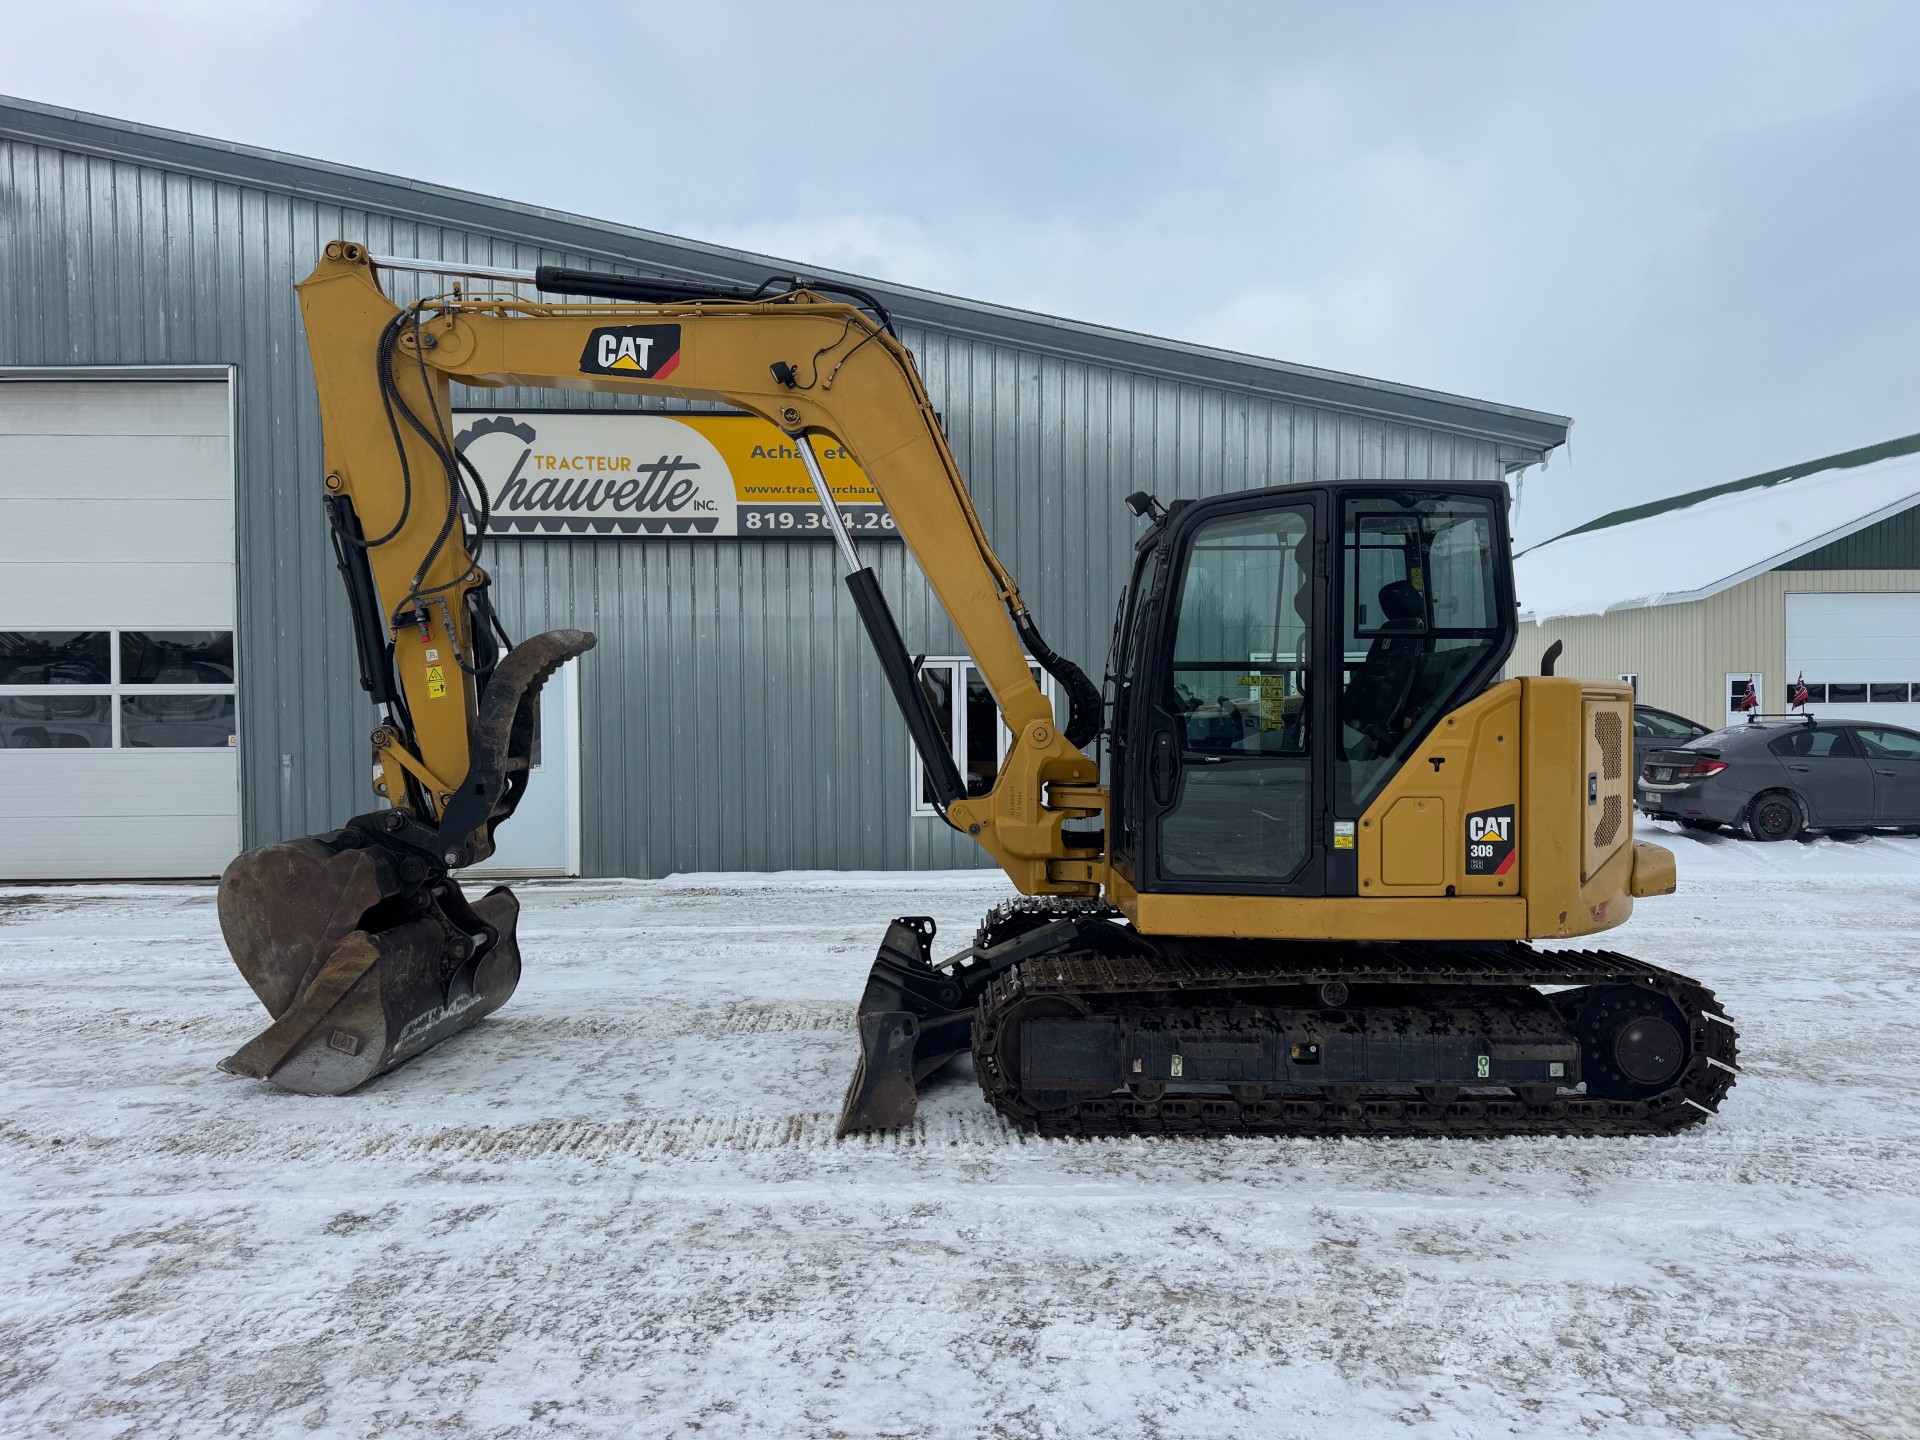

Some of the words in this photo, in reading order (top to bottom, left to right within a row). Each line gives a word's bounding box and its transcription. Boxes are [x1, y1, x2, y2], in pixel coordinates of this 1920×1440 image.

[597, 334, 654, 371] CAT
[750, 445, 816, 459] Acha
[823, 446, 847, 459] et
[533, 455, 631, 472] TRACTEUR
[693, 499, 718, 512] INC.
[1469, 816, 1511, 842] CAT
[1470, 844, 1494, 857] 308
[1470, 859, 1484, 870] CR
